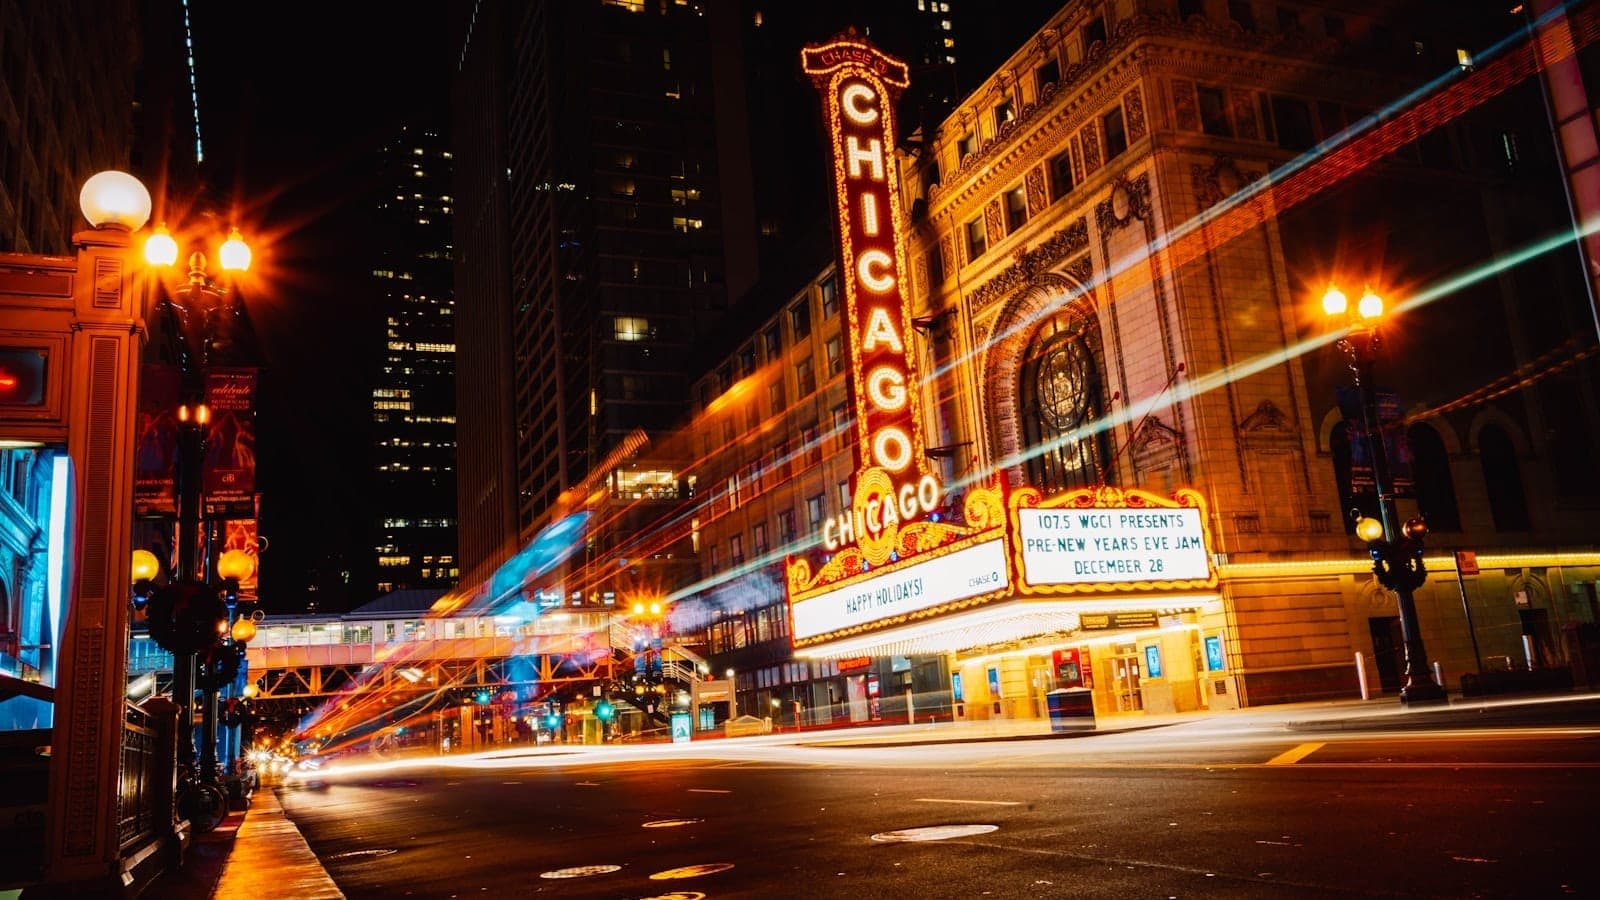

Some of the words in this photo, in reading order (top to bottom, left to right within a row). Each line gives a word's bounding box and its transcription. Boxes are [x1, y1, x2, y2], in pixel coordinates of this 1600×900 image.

[821, 50, 872, 65] CHASE
[842, 84, 912, 471] CHICAGO
[824, 475, 939, 550] CHICAGO
[1038, 515, 1071, 529] 107.5
[1078, 515, 1112, 529] WGCI
[1120, 514, 1184, 529] PRESENTS
[1027, 538, 1086, 552] PRE-NEW
[1094, 537, 1138, 551] YEARS
[1145, 536, 1169, 550] EVE
[1175, 536, 1201, 550] JAM
[1074, 560, 1142, 575] DECEMBER
[1149, 559, 1164, 573] 28
[968, 574, 991, 587] CHASE
[847, 592, 873, 615] HAPPY
[876, 578, 924, 607] HOLIDAYS!
